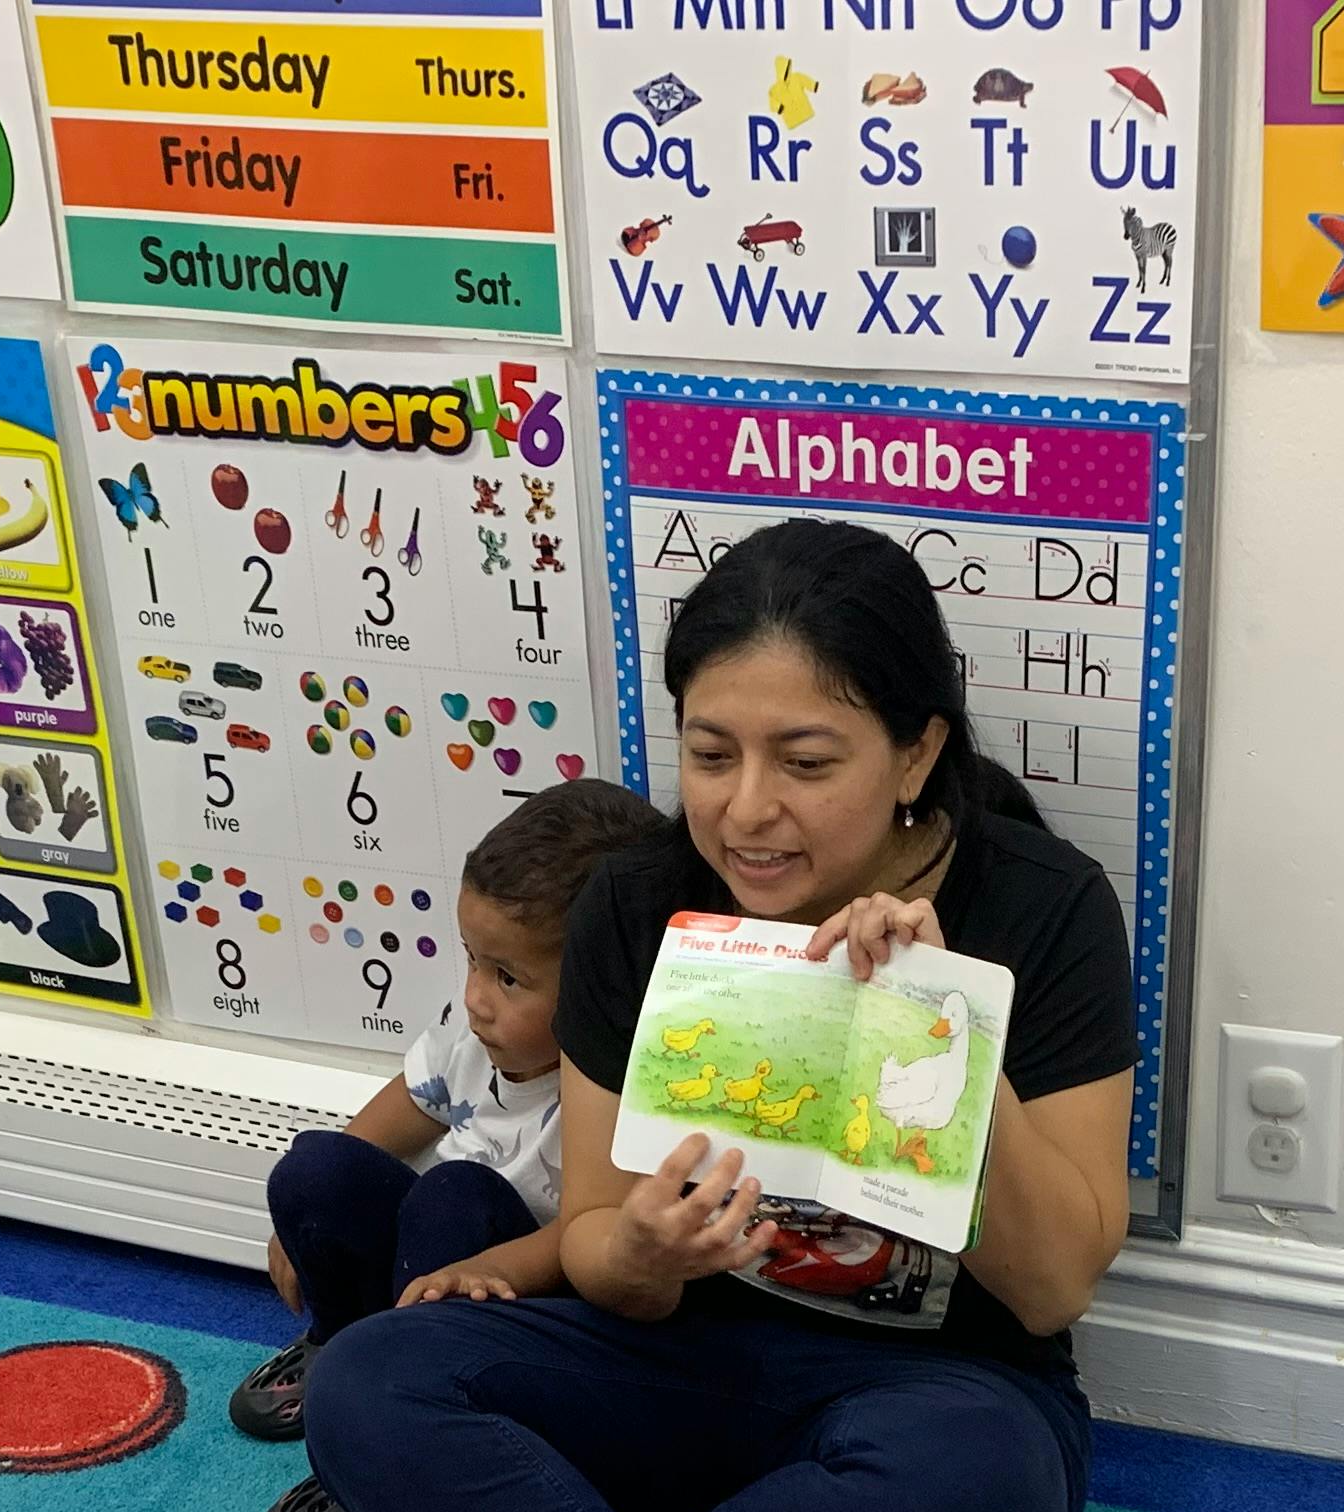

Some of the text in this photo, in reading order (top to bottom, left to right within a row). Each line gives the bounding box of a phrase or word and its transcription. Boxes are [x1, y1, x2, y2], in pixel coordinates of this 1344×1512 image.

[108, 32, 526, 110] Thursday Thurs.
[159, 135, 505, 208] Friday Fri.
[602, 112, 1176, 198] Qq Rr Ss Tt Uu
[139, 234, 521, 313] Saturday Sat.
[608, 258, 1172, 358] Vv Ww Xx Yy Zz
[147, 362, 468, 450] numbers
[727, 416, 1034, 497] Alphabet
[144, 547, 158, 604] 1
[242, 556, 278, 615] 2
[361, 566, 395, 626] 3
[1035, 537, 1119, 605] Dd
[138, 609, 175, 629] one
[243, 615, 284, 639] two
[509, 579, 549, 641] 4
[355, 626, 410, 652] three
[515, 639, 562, 666] four
[1024, 629, 1106, 697] Hh
[14, 710, 58, 727] purple
[202, 753, 234, 808] 5
[346, 771, 377, 825] 6
[203, 808, 240, 833] five
[353, 834, 383, 853] six
[41, 849, 70, 865] gray
[216, 939, 246, 990] 8
[679, 936, 715, 951] Five
[720, 939, 768, 956] Little
[30, 972, 66, 990] black
[213, 993, 261, 1018] eight
[362, 959, 393, 1010] 9
[361, 1014, 404, 1035] nine
[886, 1184, 909, 1197] parade
